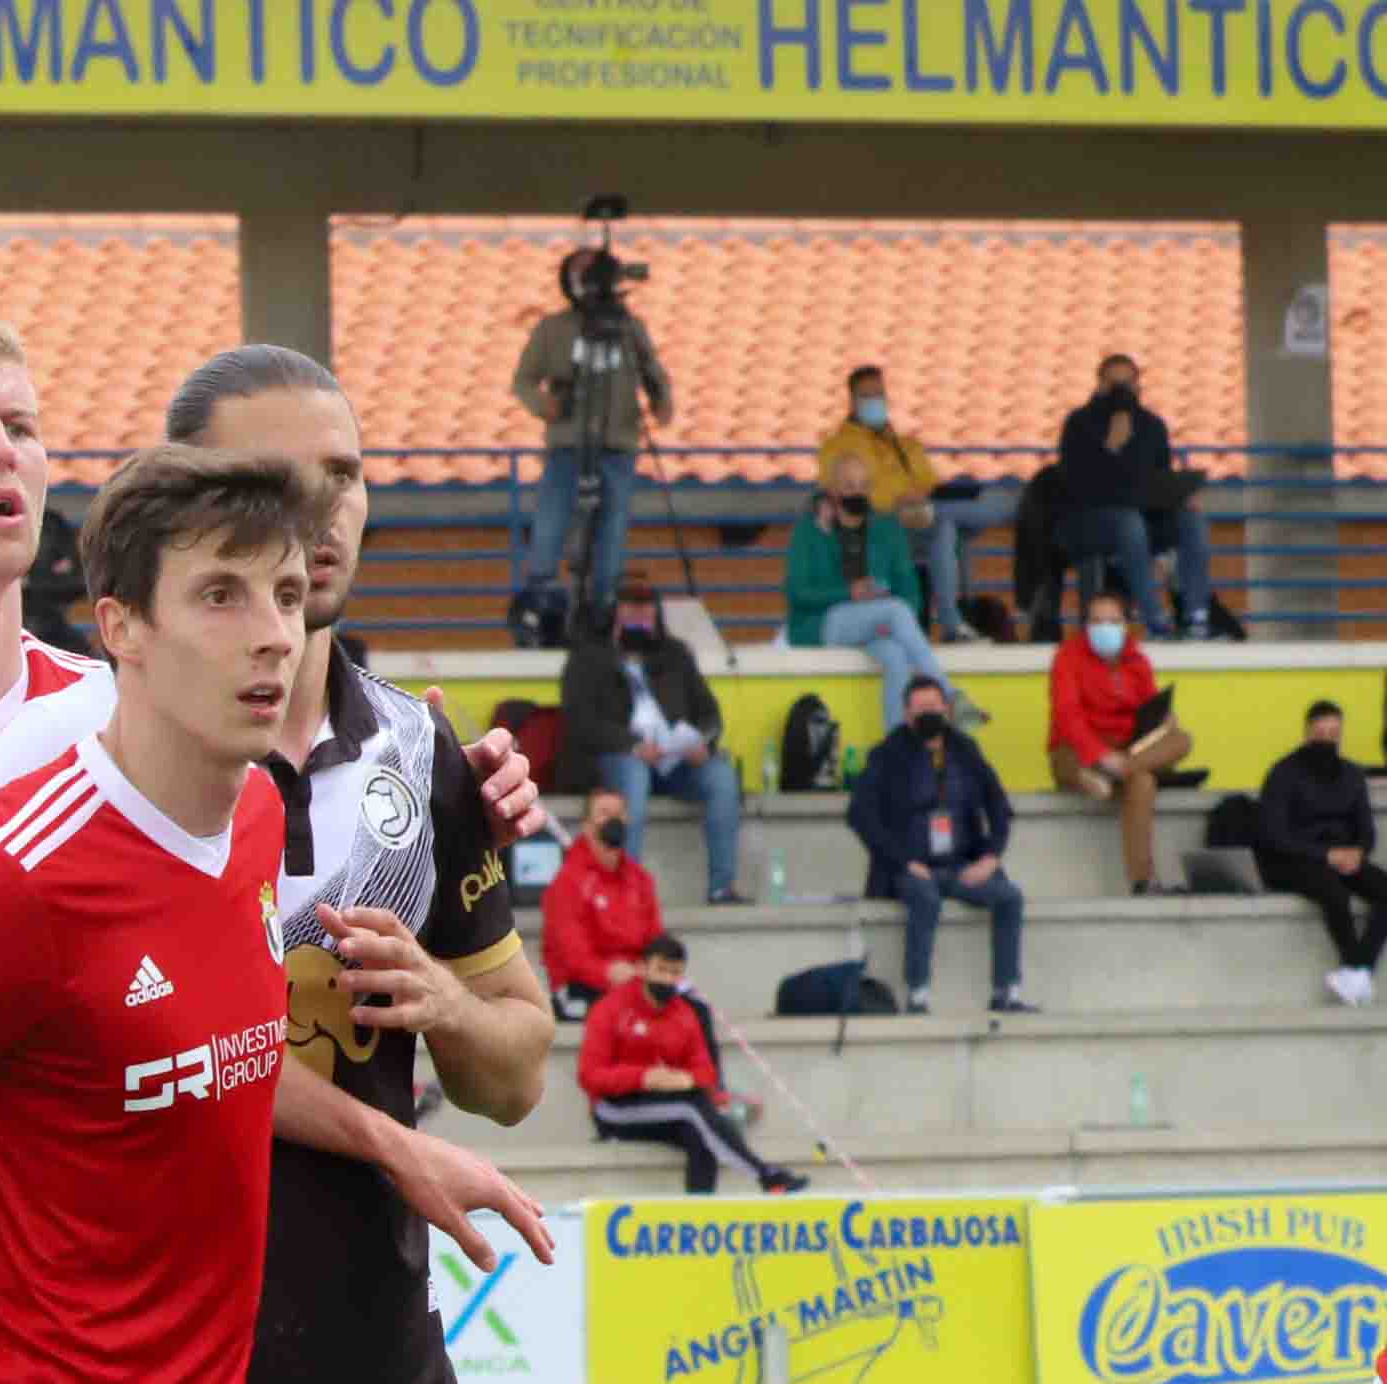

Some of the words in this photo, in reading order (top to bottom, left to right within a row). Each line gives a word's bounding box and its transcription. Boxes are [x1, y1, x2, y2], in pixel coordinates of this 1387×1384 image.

[516, 61, 731, 89] PROFESIONAL
[125, 979, 175, 1007] adidas
[123, 1044, 214, 1112] SR
[221, 1050, 278, 1091] GROUP
[840, 1201, 1021, 1250] CARBAJOSA
[1157, 1207, 1271, 1257] IRISH
[1288, 1207, 1367, 1249] PUB
